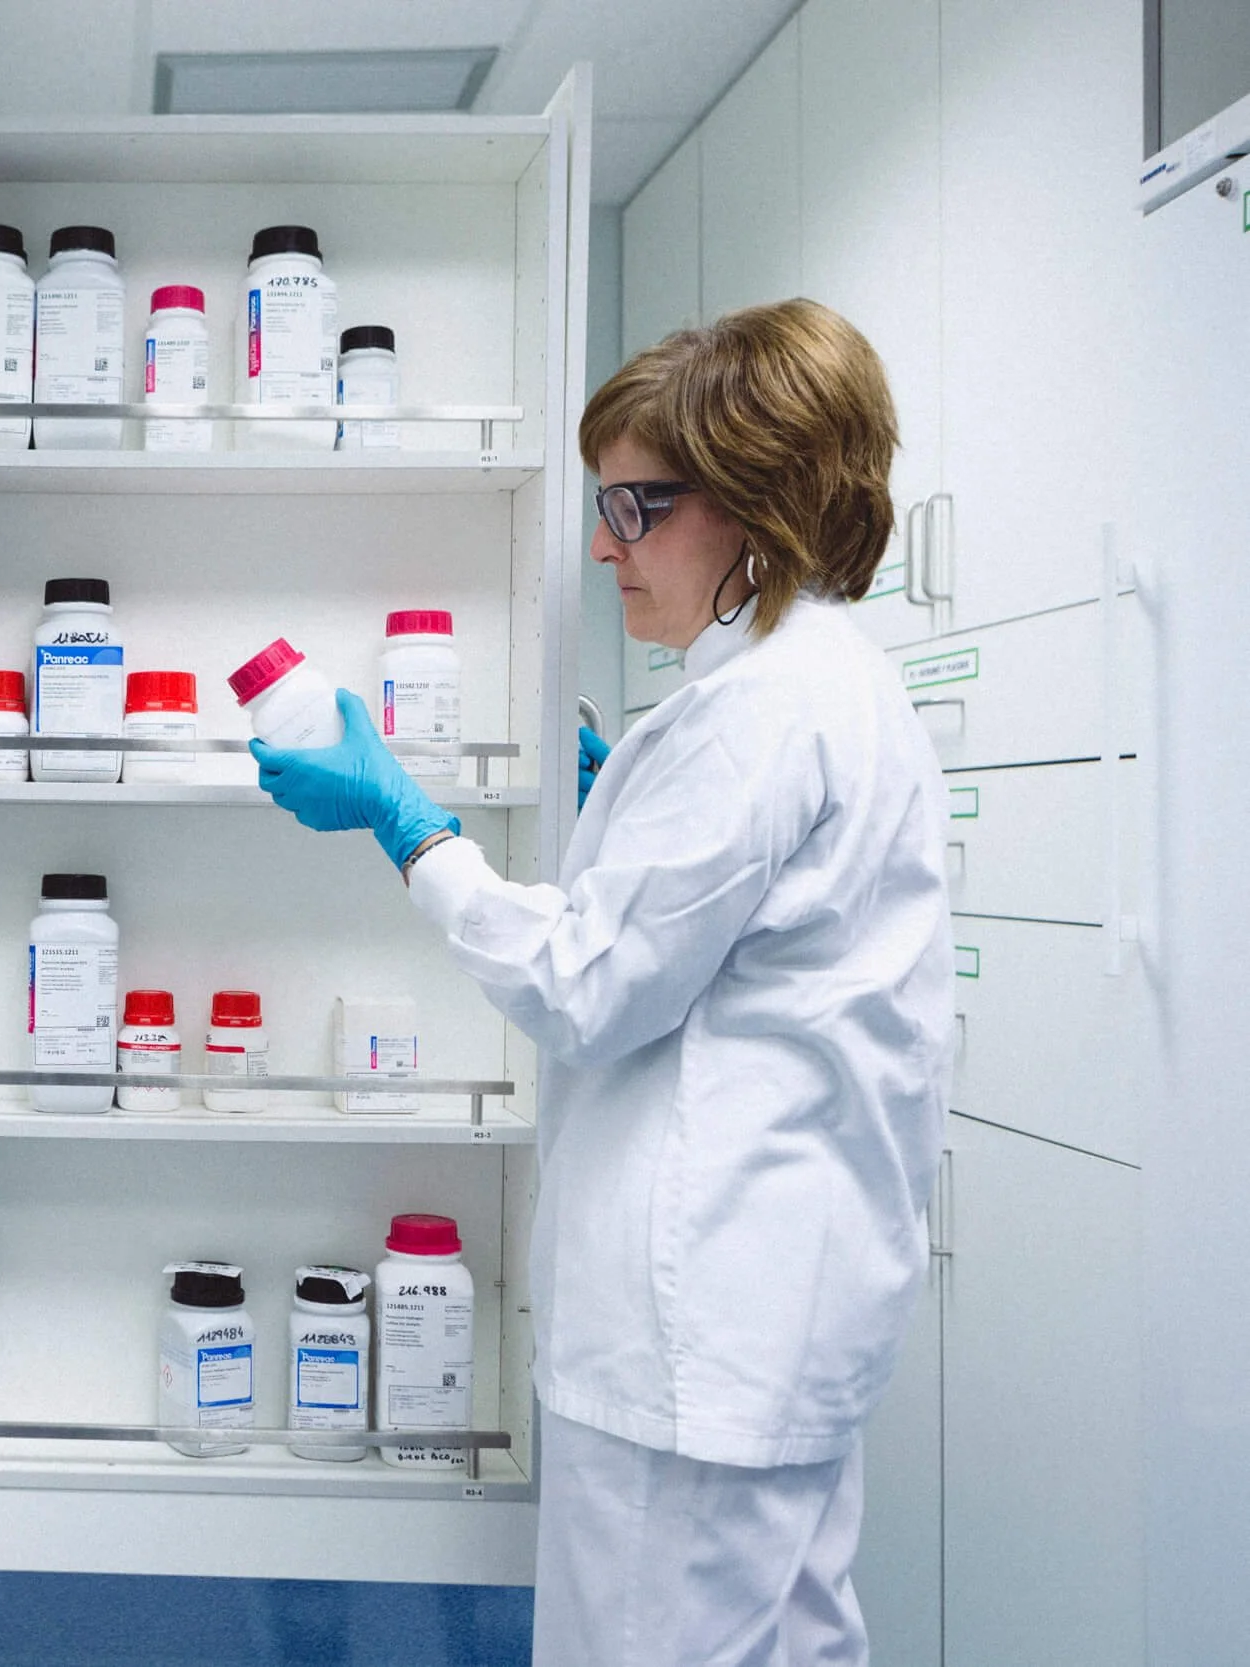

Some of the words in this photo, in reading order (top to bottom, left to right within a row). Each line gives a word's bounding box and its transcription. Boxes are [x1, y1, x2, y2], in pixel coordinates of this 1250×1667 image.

[267, 276, 318, 288] 170.785
[42, 651, 89, 664] Panreac
[398, 1285, 447, 1297] 216.988
[196, 1325, 244, 1344] 1129484
